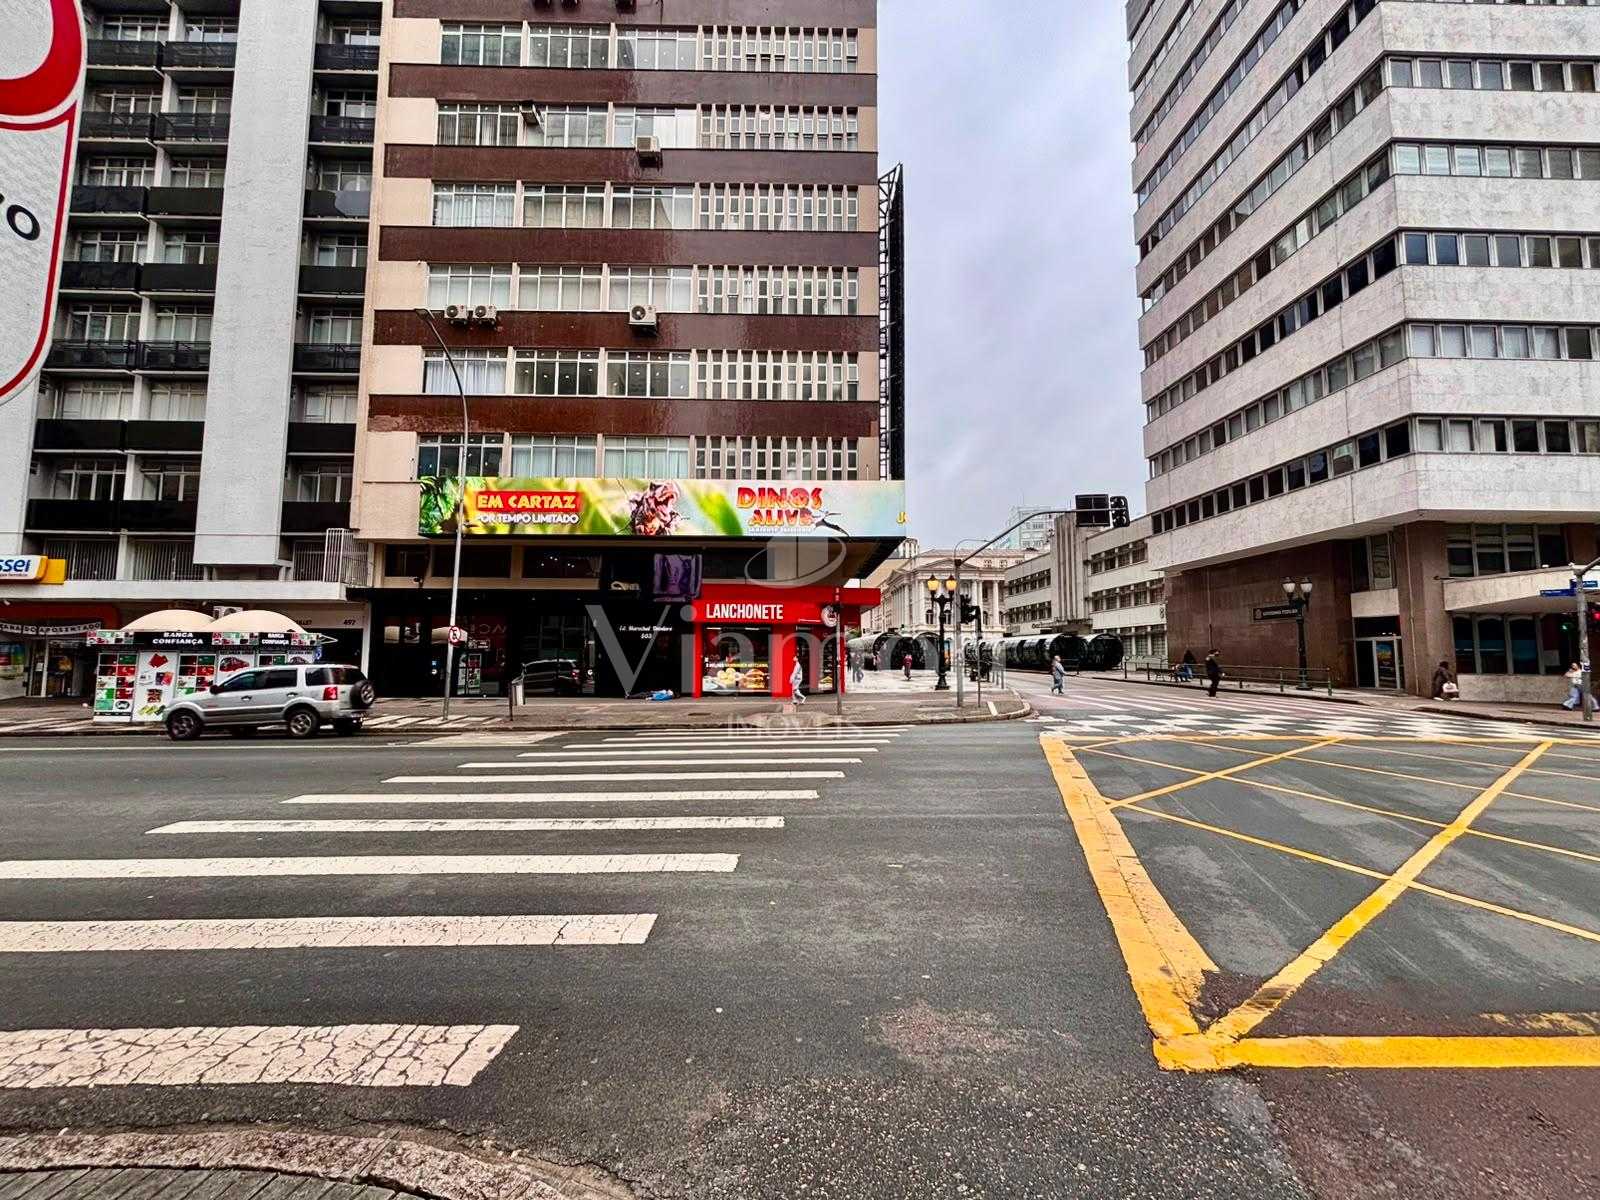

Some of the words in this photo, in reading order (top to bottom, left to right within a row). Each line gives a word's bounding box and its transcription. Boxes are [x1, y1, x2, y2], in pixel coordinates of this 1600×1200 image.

[477, 495, 504, 509] EM
[508, 495, 576, 509] CARTAZ
[736, 487, 822, 510] DINOS
[500, 513, 531, 524] TEMPO
[532, 513, 580, 524] LIMITADO
[748, 509, 813, 527] ALIVE
[706, 603, 784, 620] LANCHONETE
[152, 638, 204, 646] CONFIANÇA
